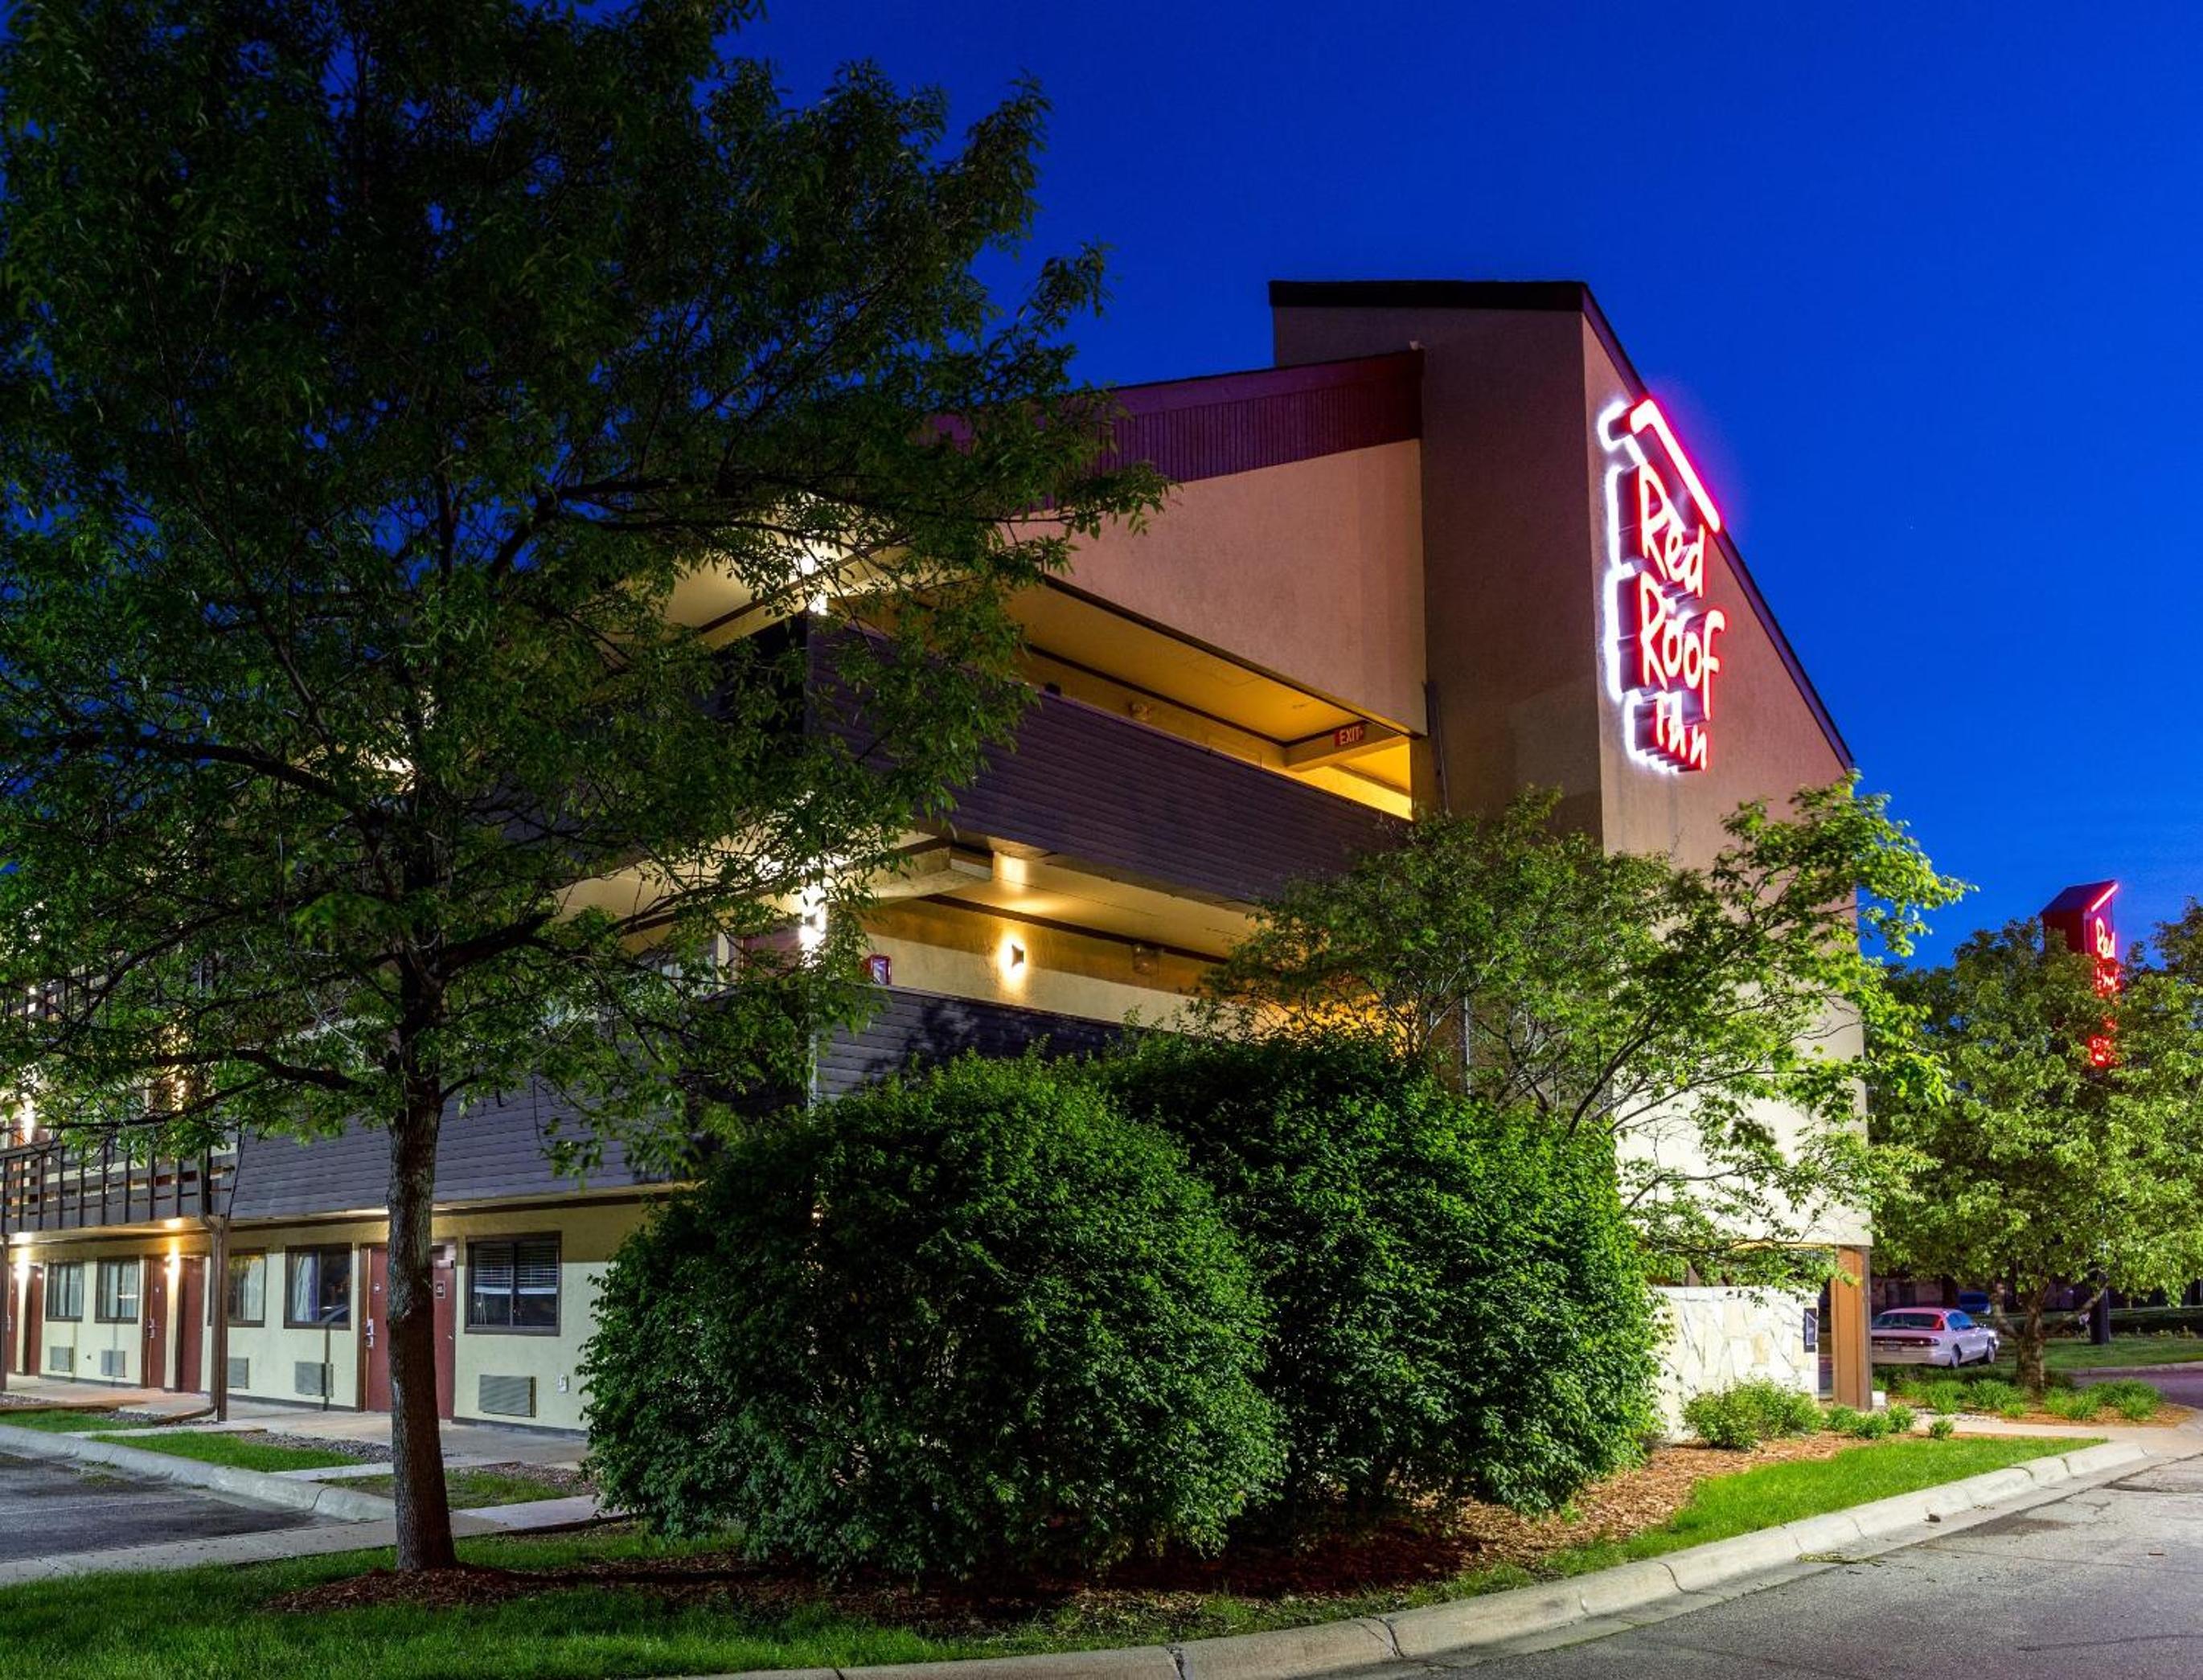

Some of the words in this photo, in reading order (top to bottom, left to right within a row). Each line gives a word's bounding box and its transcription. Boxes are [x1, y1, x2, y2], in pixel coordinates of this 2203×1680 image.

[1639, 465, 1706, 598] Red
[1639, 573, 1725, 720] Roof
[1339, 727, 1360, 745] EXIT
[1656, 698, 1707, 770] Inn
